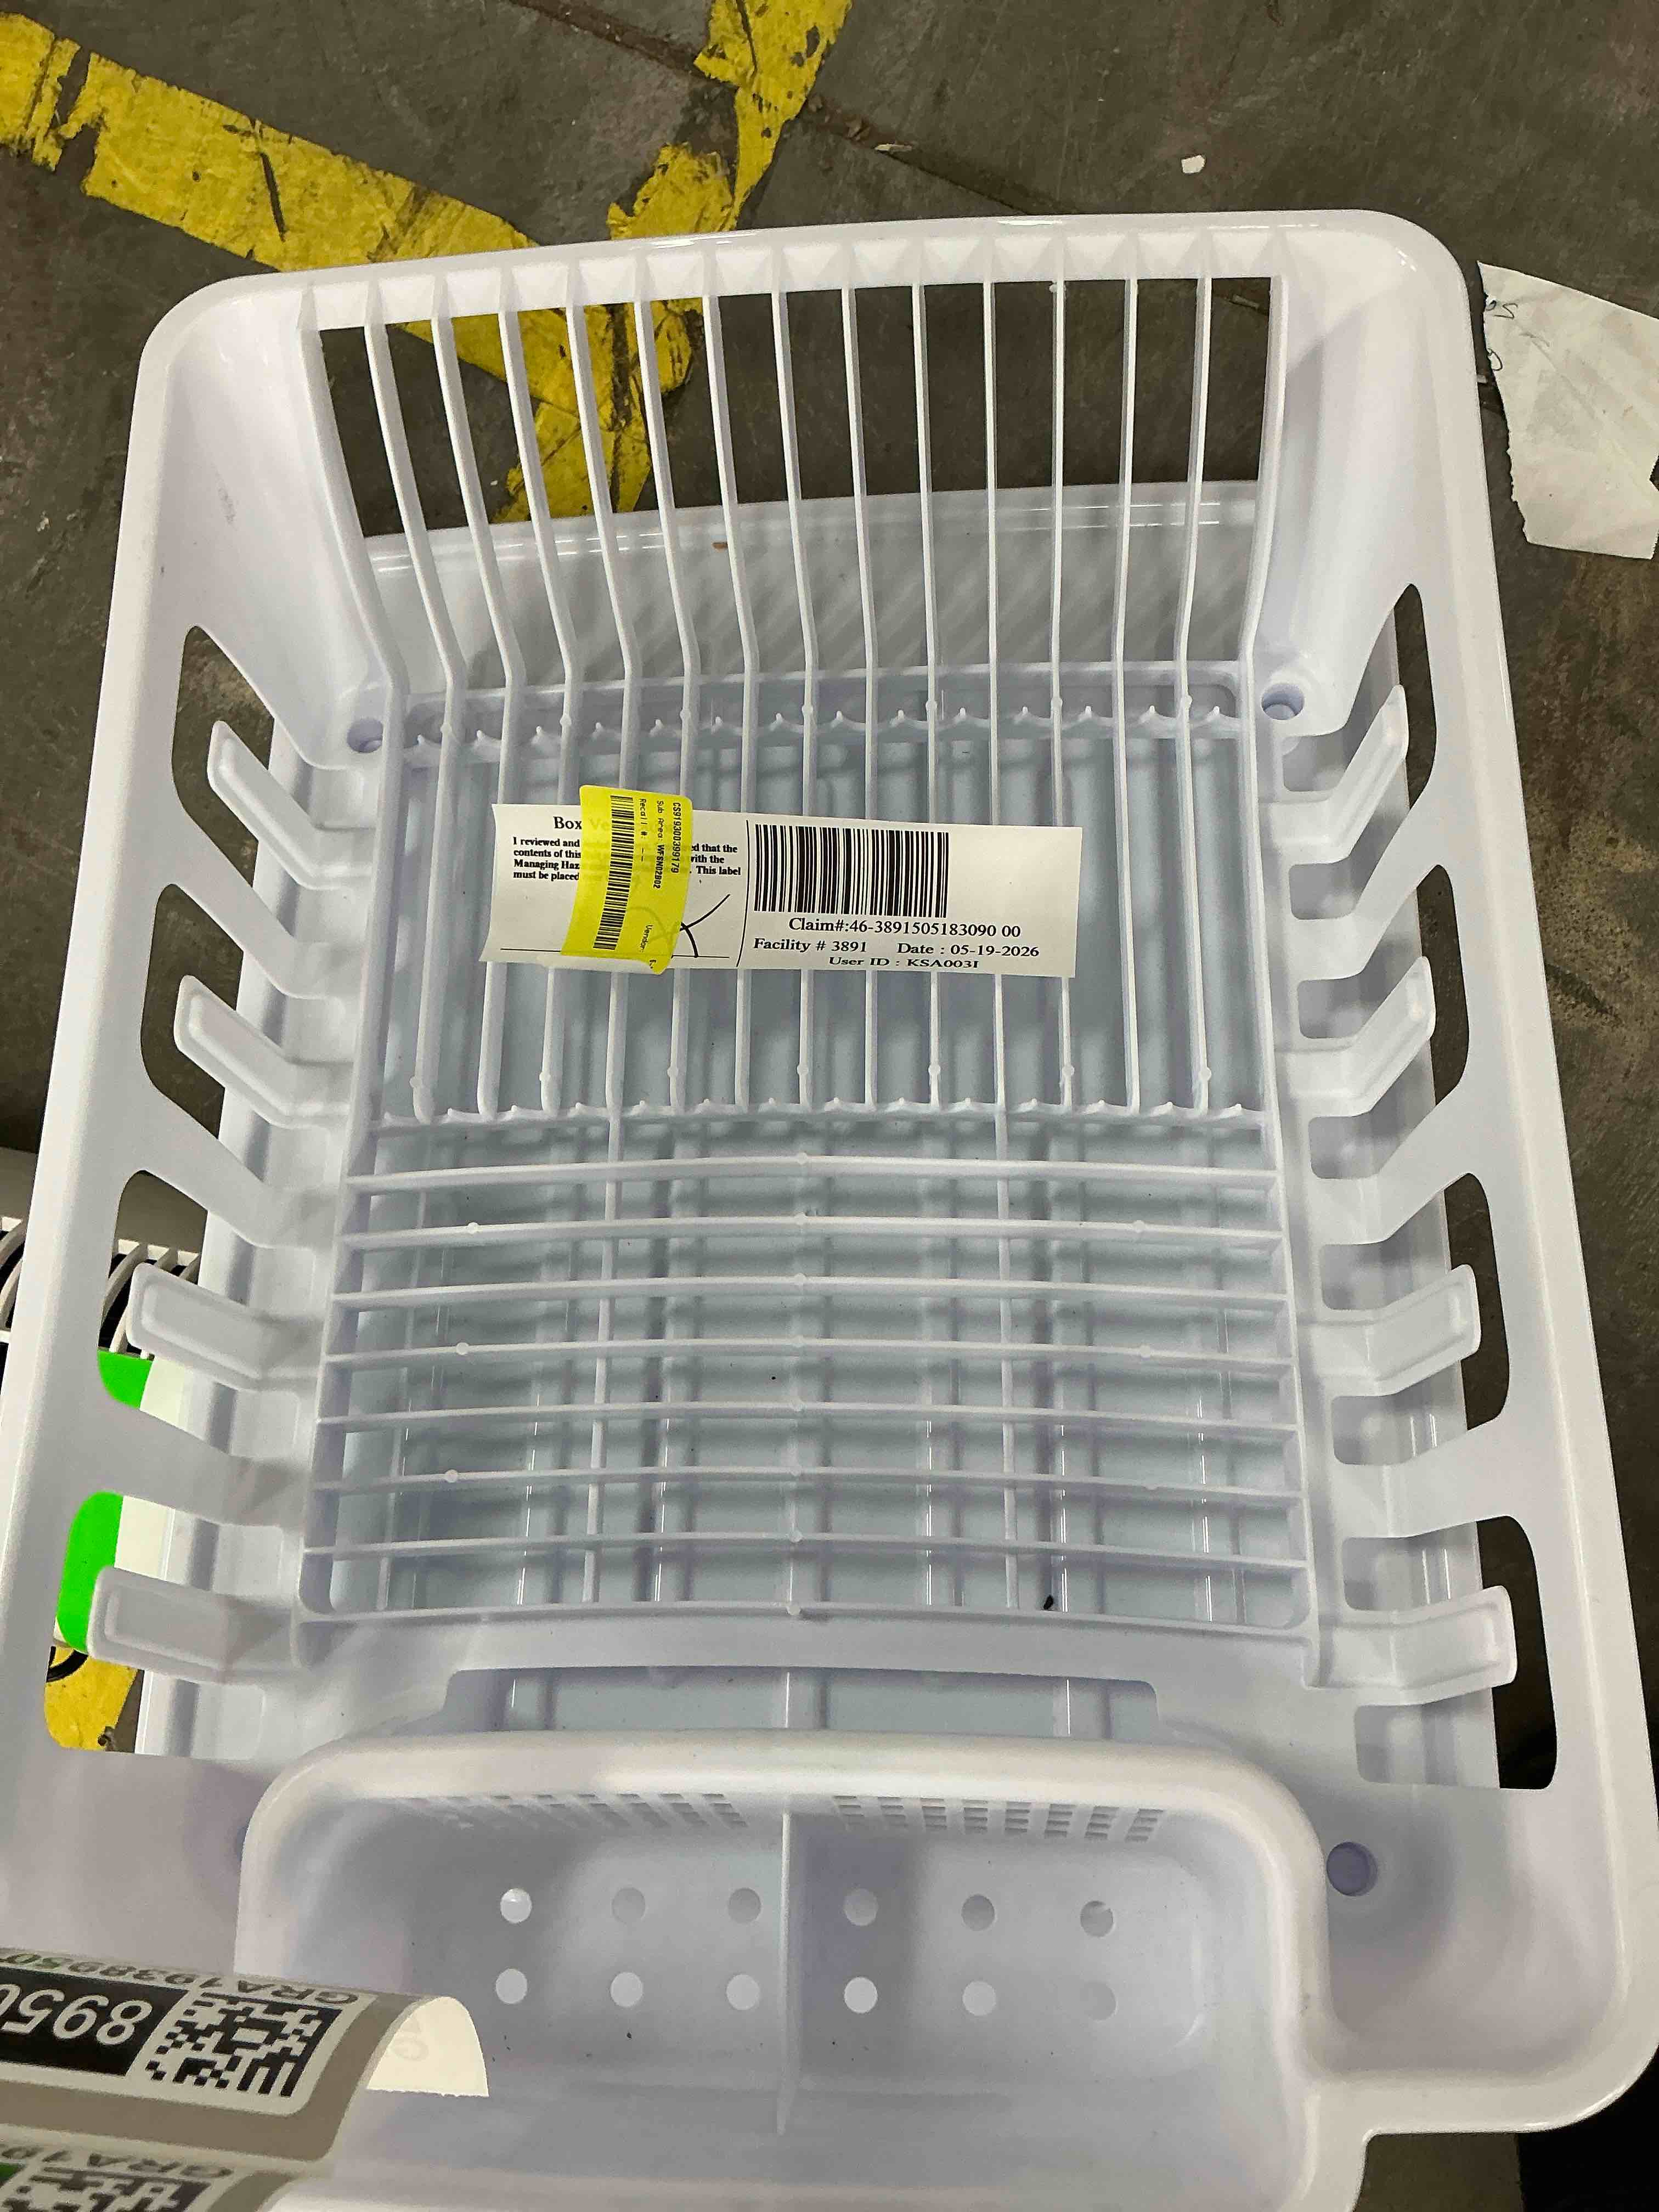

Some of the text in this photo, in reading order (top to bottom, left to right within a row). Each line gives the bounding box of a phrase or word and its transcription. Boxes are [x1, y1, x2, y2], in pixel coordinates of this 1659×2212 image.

[553, 816, 582, 830] Box
[671, 802, 681, 873] CS919300399179
[513, 837, 517, 845] I
[520, 838, 560, 847] reviewed
[702, 843, 721, 852] that
[723, 844, 738, 853] the
[514, 849, 551, 857] contents
[709, 855, 725, 864] the
[514, 859, 741, 876] Managing Haz This label
[551, 872, 579, 882] placed
[1001, 925, 1021, 937] 00
[753, 938, 867, 952] Facility # 3891
[897, 943, 934, 954] Date
[950, 944, 1040, 957] 05-19-2026
[829, 957, 864, 966] User
[870, 958, 890, 966] ID
